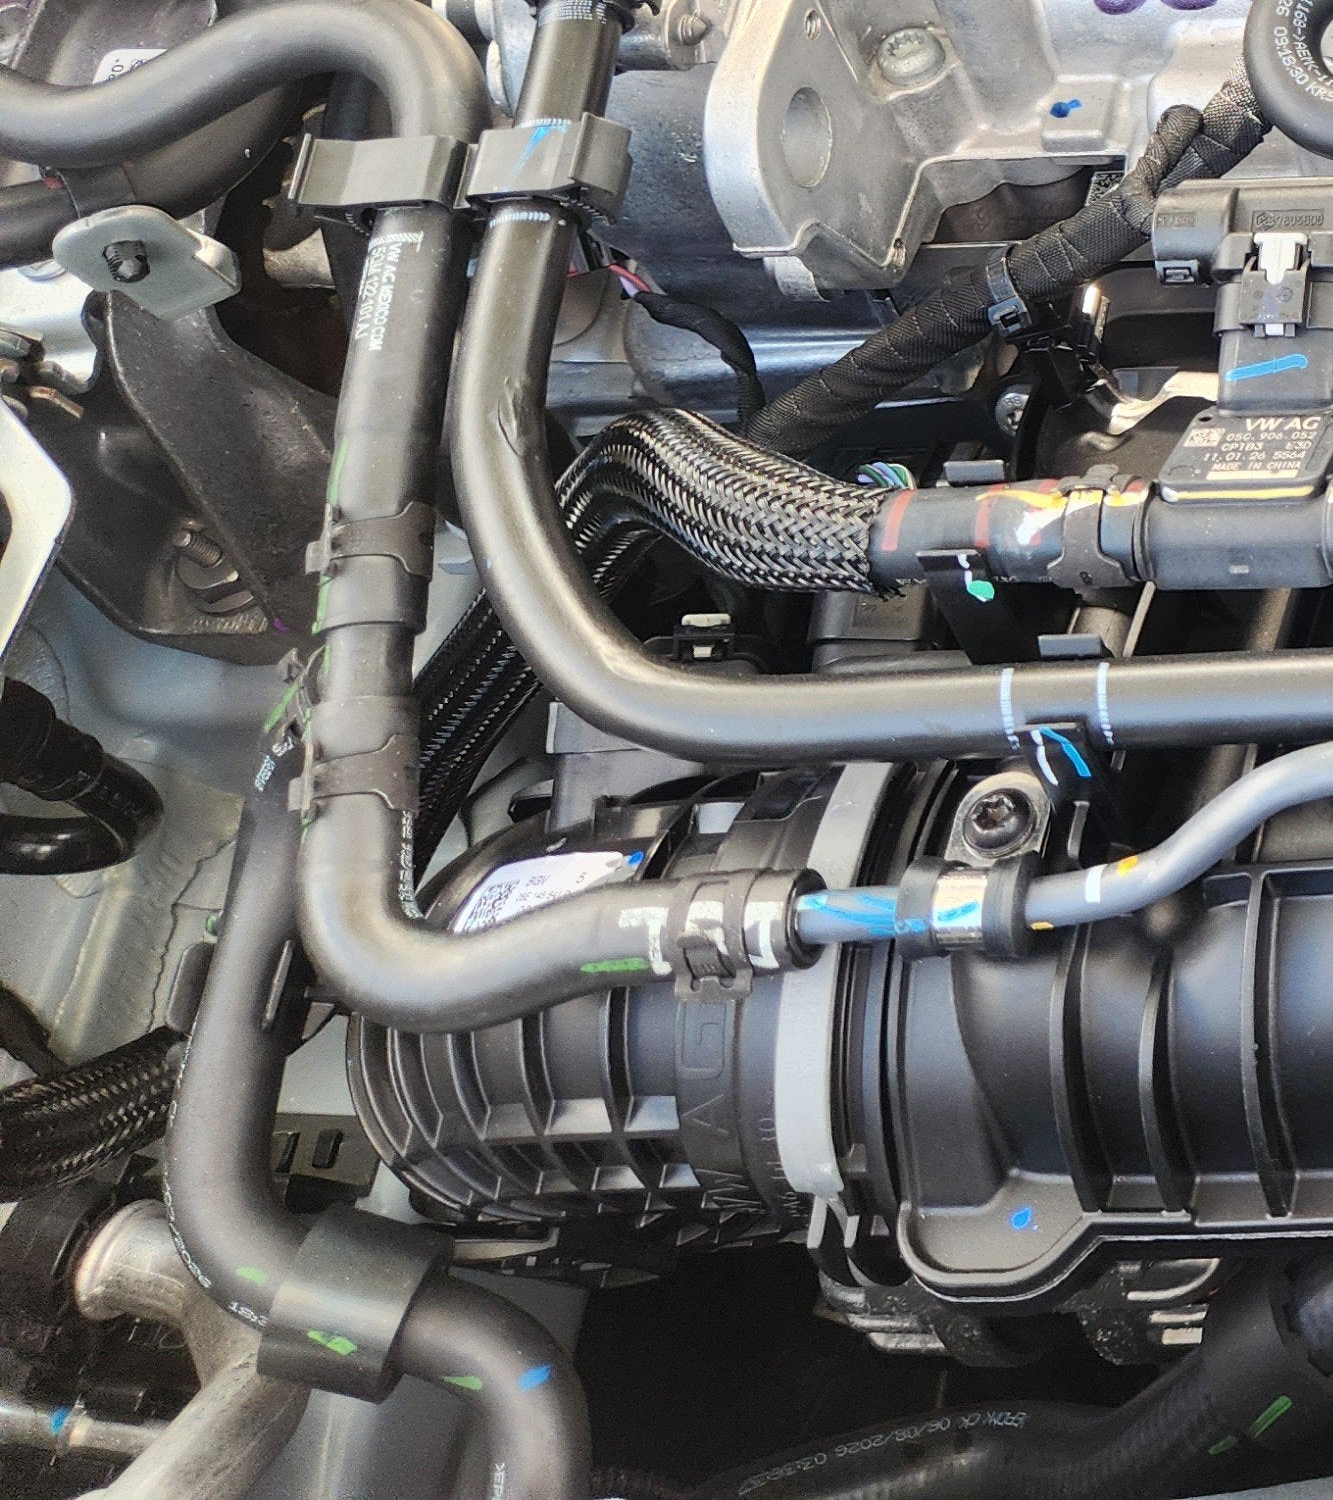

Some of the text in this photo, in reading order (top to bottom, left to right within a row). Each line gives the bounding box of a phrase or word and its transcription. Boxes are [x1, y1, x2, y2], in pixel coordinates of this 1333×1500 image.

[1245, 416, 1322, 431] VW AG
[1212, 461, 1301, 471] MADE IN CHINA
